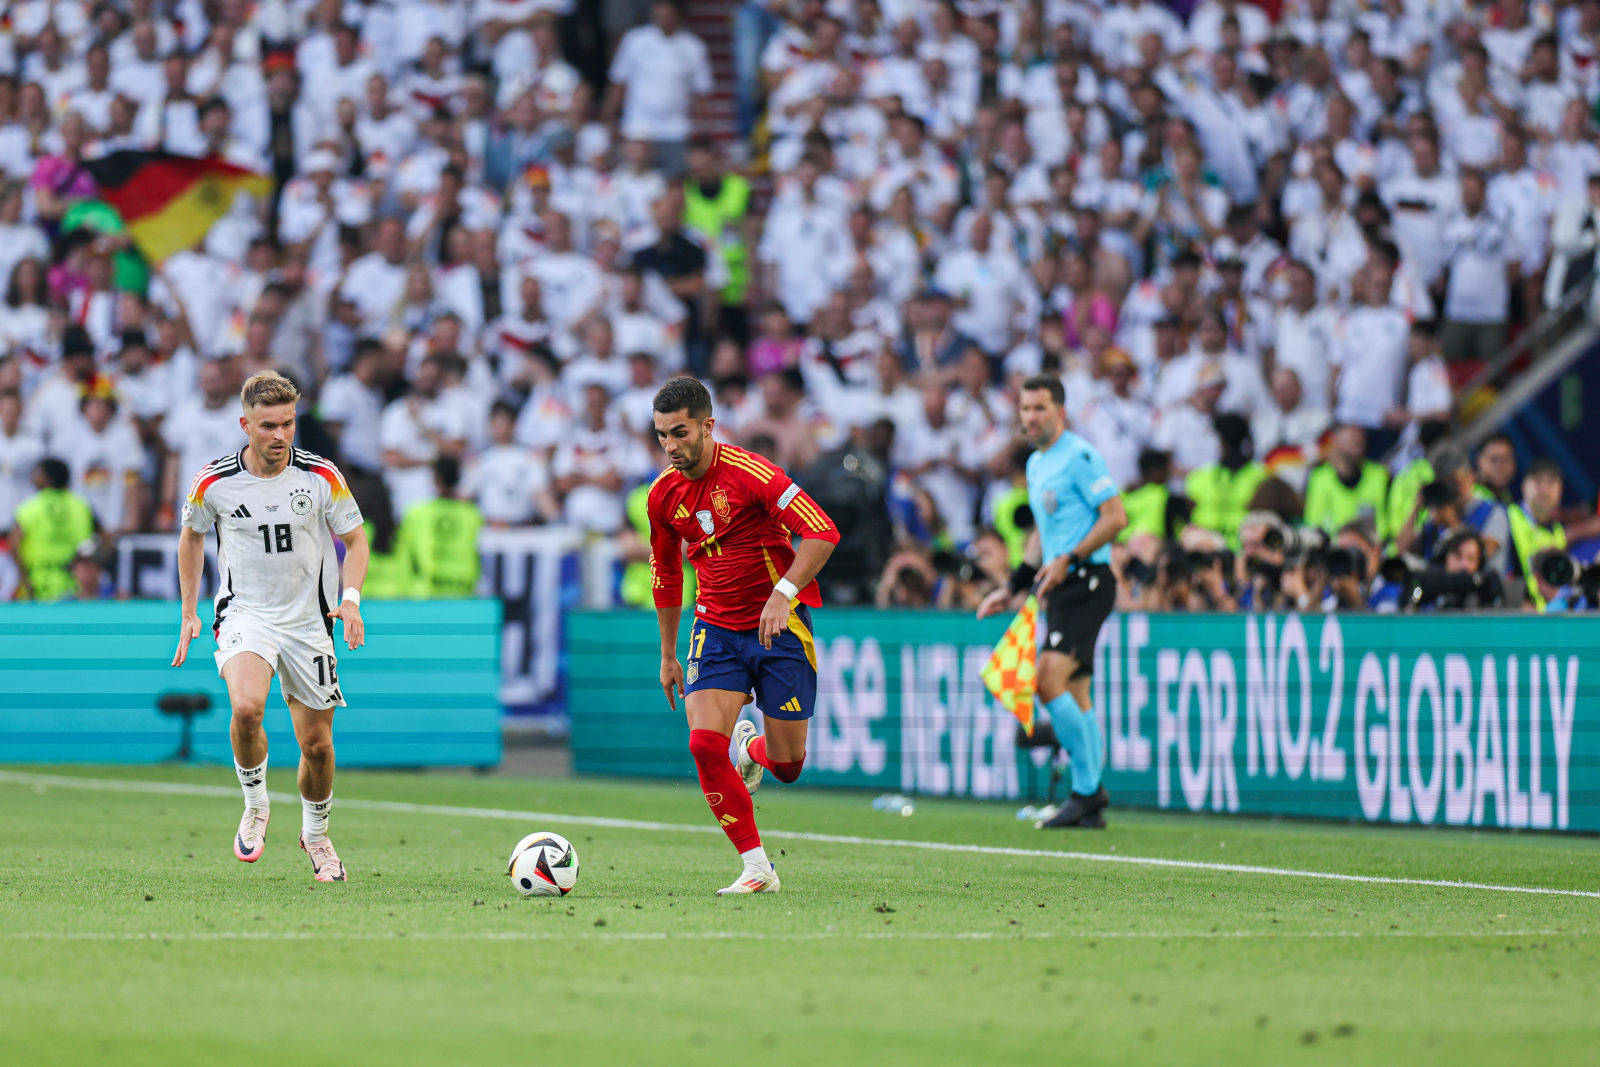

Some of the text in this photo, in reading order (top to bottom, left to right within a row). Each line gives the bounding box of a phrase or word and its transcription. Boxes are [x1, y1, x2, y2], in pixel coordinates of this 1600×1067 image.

[258, 523, 293, 553] 18
[1157, 648, 1240, 813] FOR
[1245, 613, 1346, 782] NO.2
[1353, 651, 1579, 830] GLOBALLY
